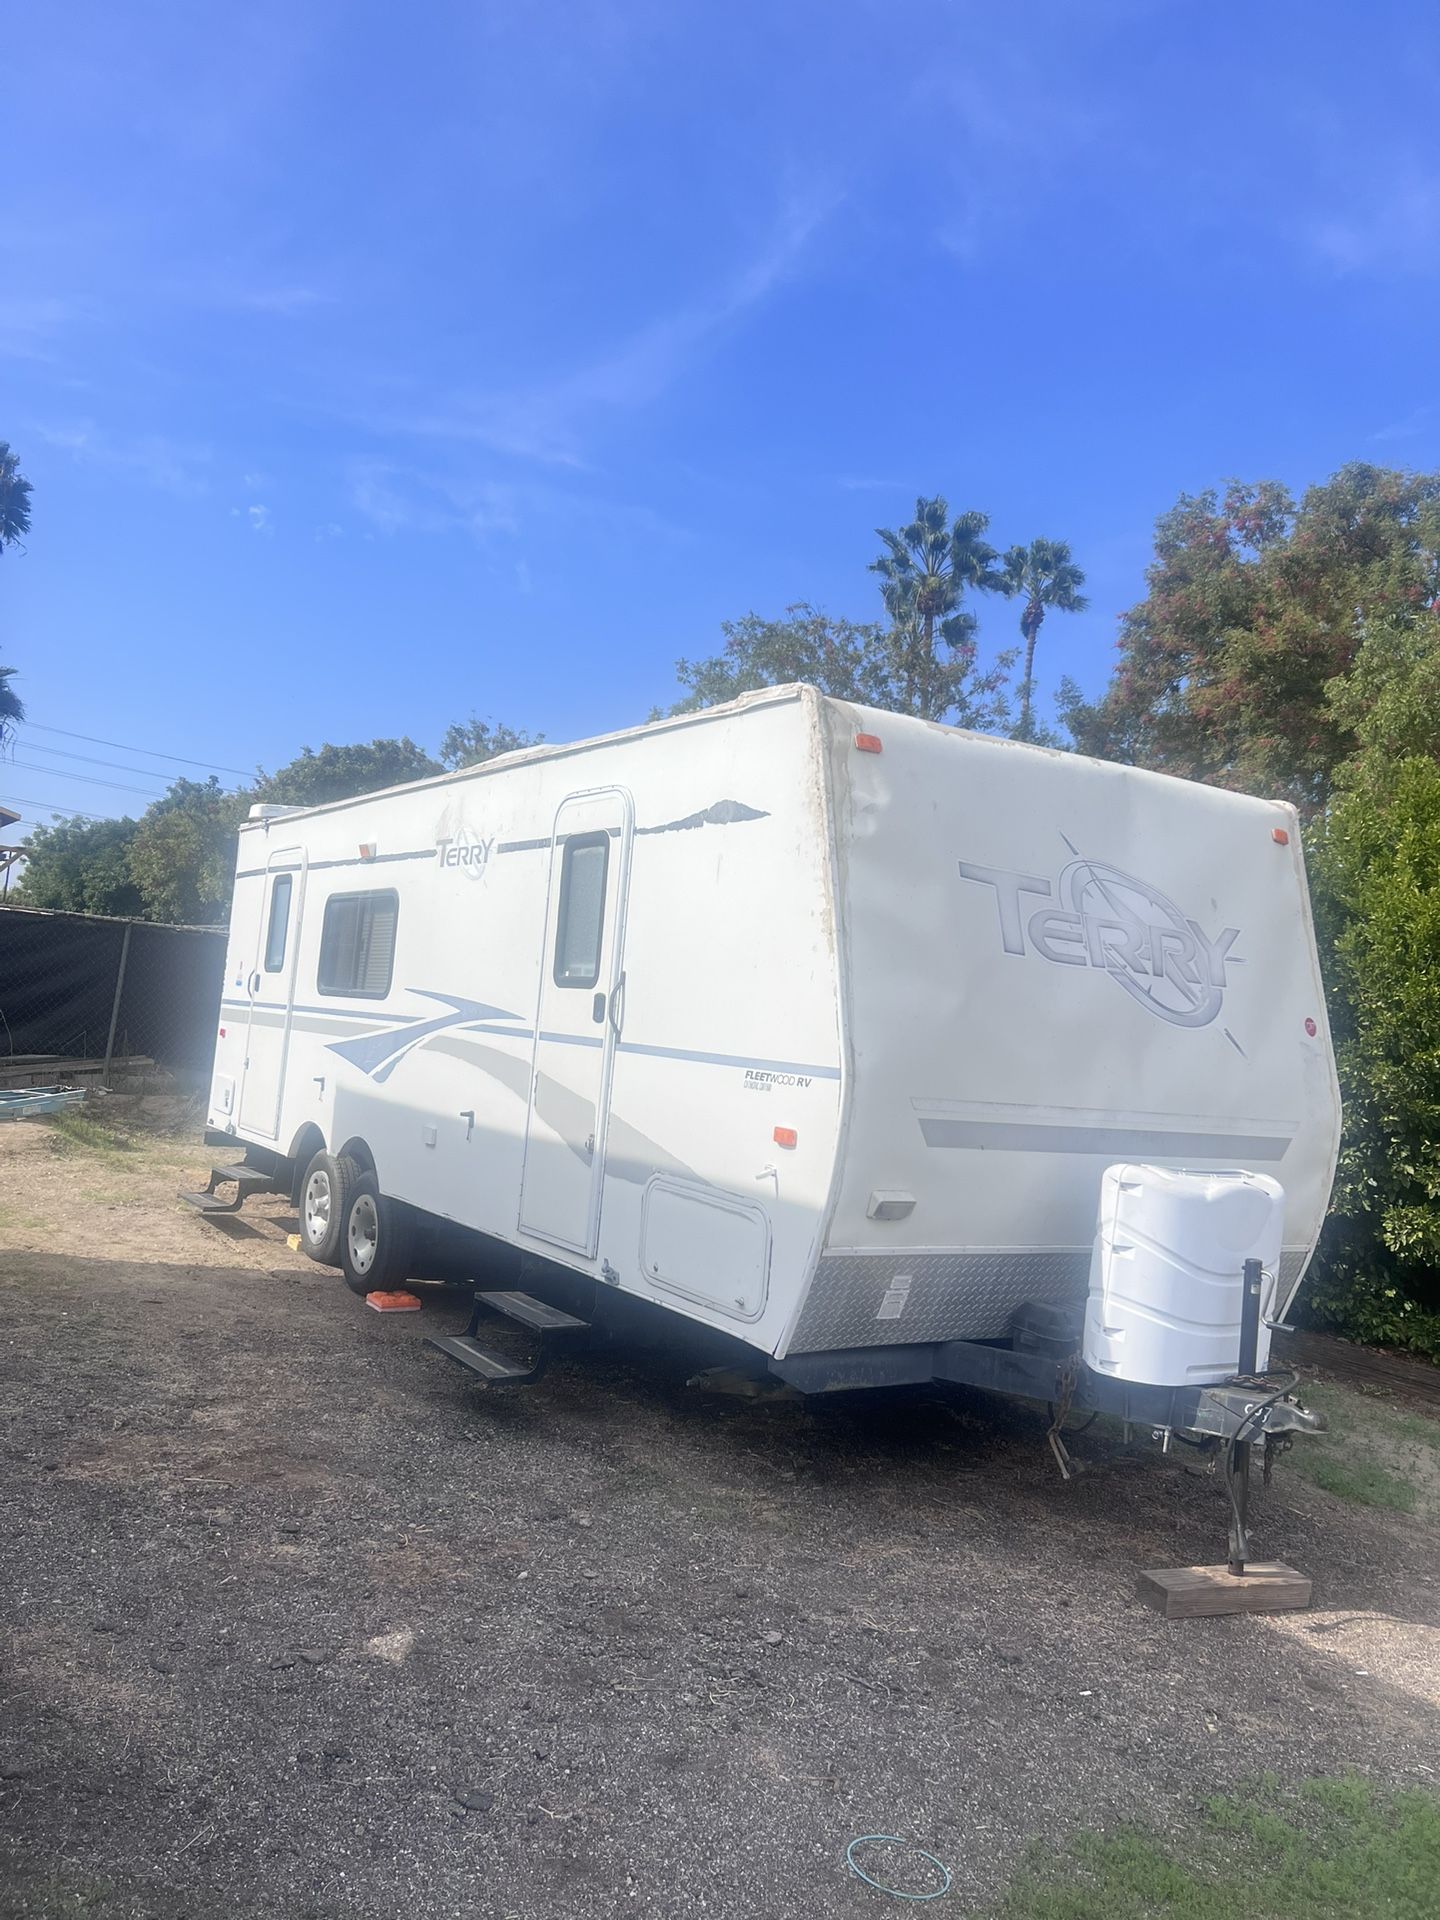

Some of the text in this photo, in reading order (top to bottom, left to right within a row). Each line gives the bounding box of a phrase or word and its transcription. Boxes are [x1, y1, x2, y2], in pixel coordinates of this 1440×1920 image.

[436, 837, 495, 867] TERRY
[957, 859, 1241, 988] TERRY
[745, 1070, 796, 1087] FLEETWOOD
[796, 1077, 812, 1087] RV
